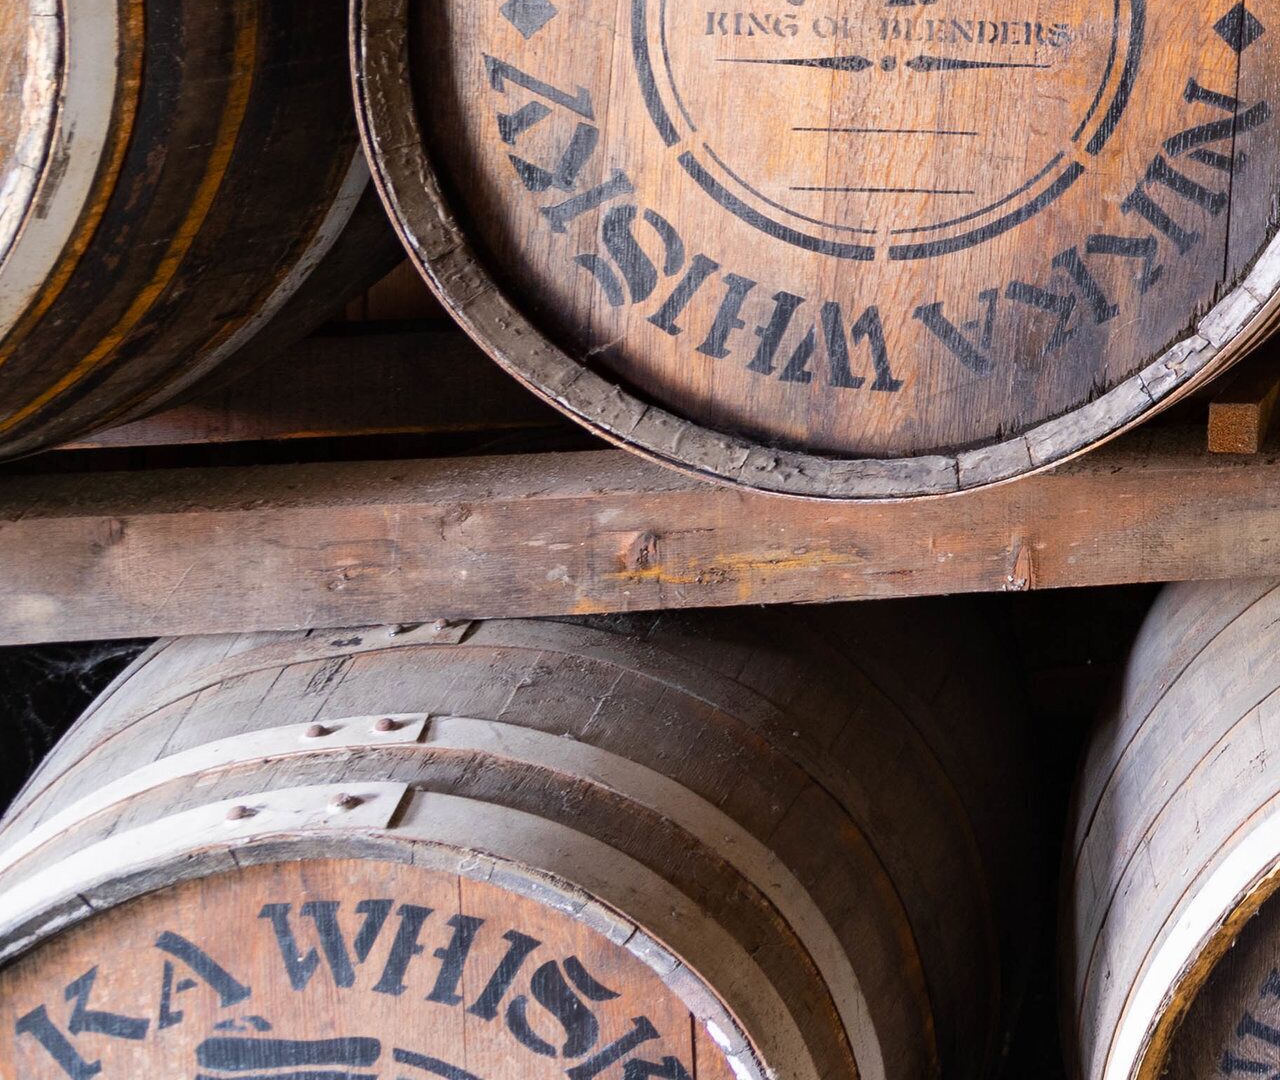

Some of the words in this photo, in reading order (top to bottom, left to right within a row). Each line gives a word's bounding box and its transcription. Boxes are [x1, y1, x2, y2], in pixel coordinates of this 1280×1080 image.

[705, 11, 799, 38] KING
[880, 16, 1073, 48] BLENDERS
[482, 51, 905, 391] WHISKY
[912, 78, 1270, 377] NIKKA
